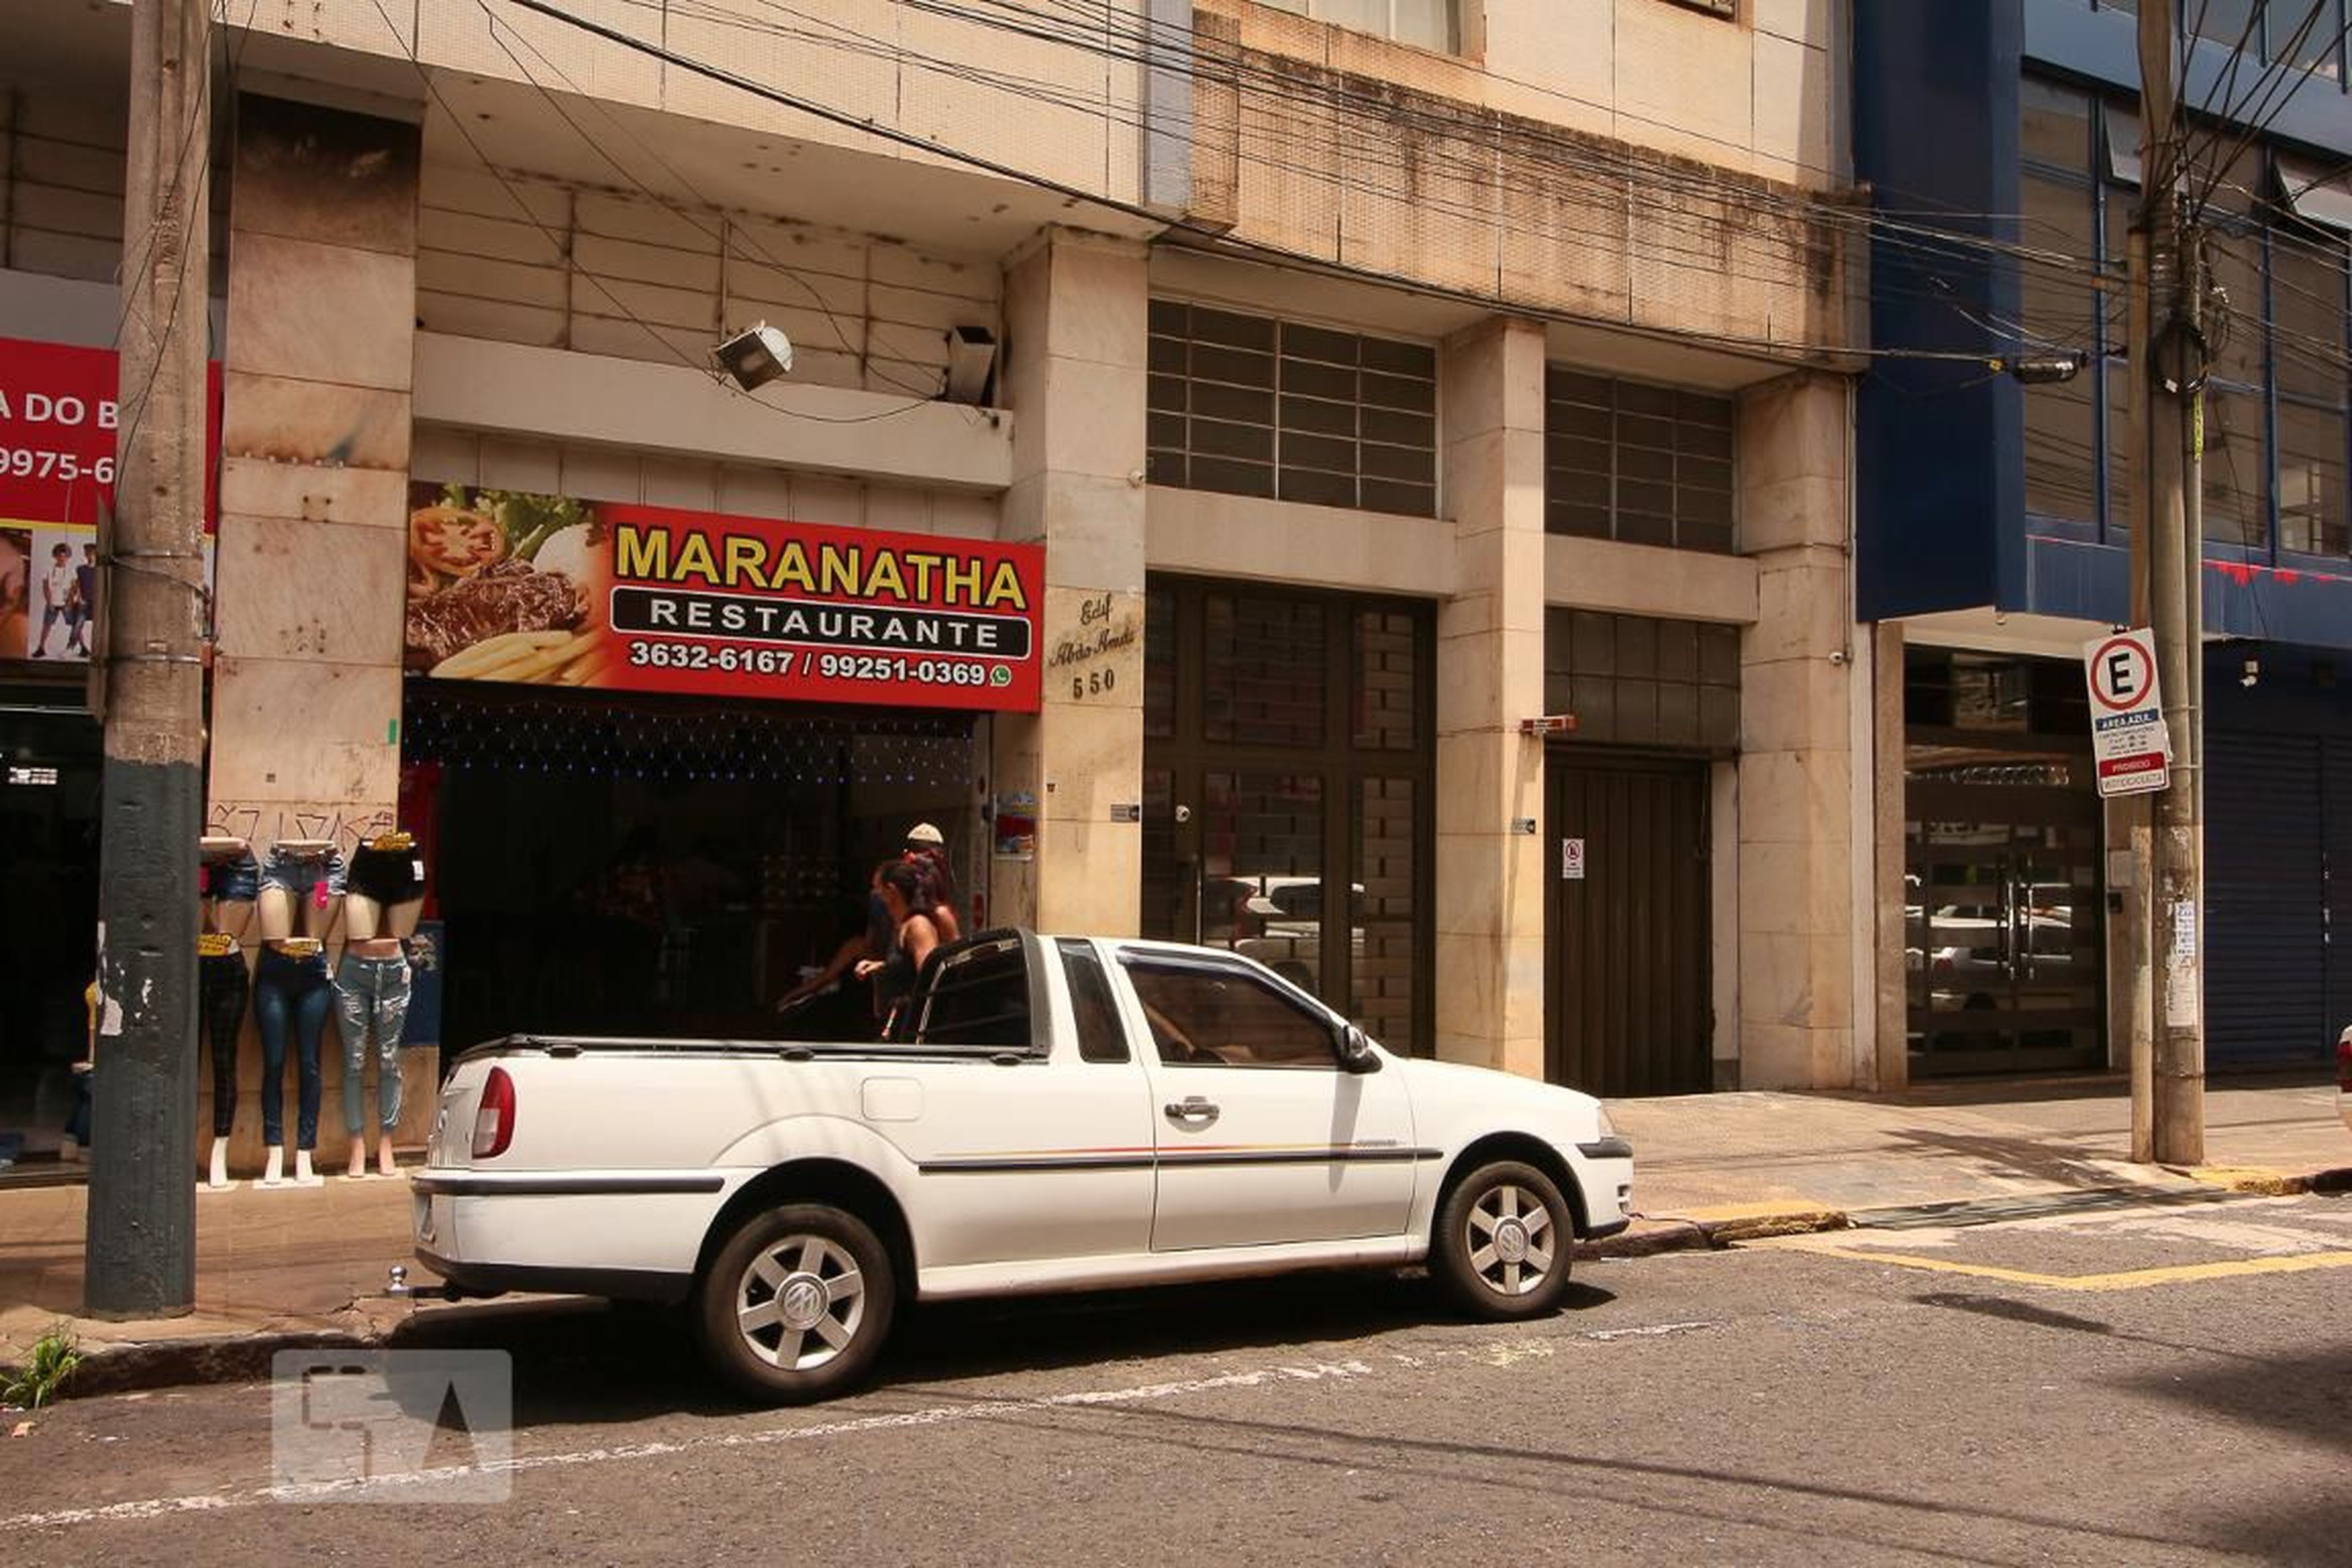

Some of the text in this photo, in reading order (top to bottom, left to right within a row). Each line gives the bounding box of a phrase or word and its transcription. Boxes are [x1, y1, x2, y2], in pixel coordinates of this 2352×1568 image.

[25, 393, 85, 425] DO
[615, 524, 1027, 611] MARANATHA
[650, 598, 998, 649] RESTAURANTE
[630, 641, 794, 675] 3632-6167
[820, 654, 986, 686] 99251-0369
[1073, 668, 1115, 699] 550
[2108, 653, 2134, 696] E
